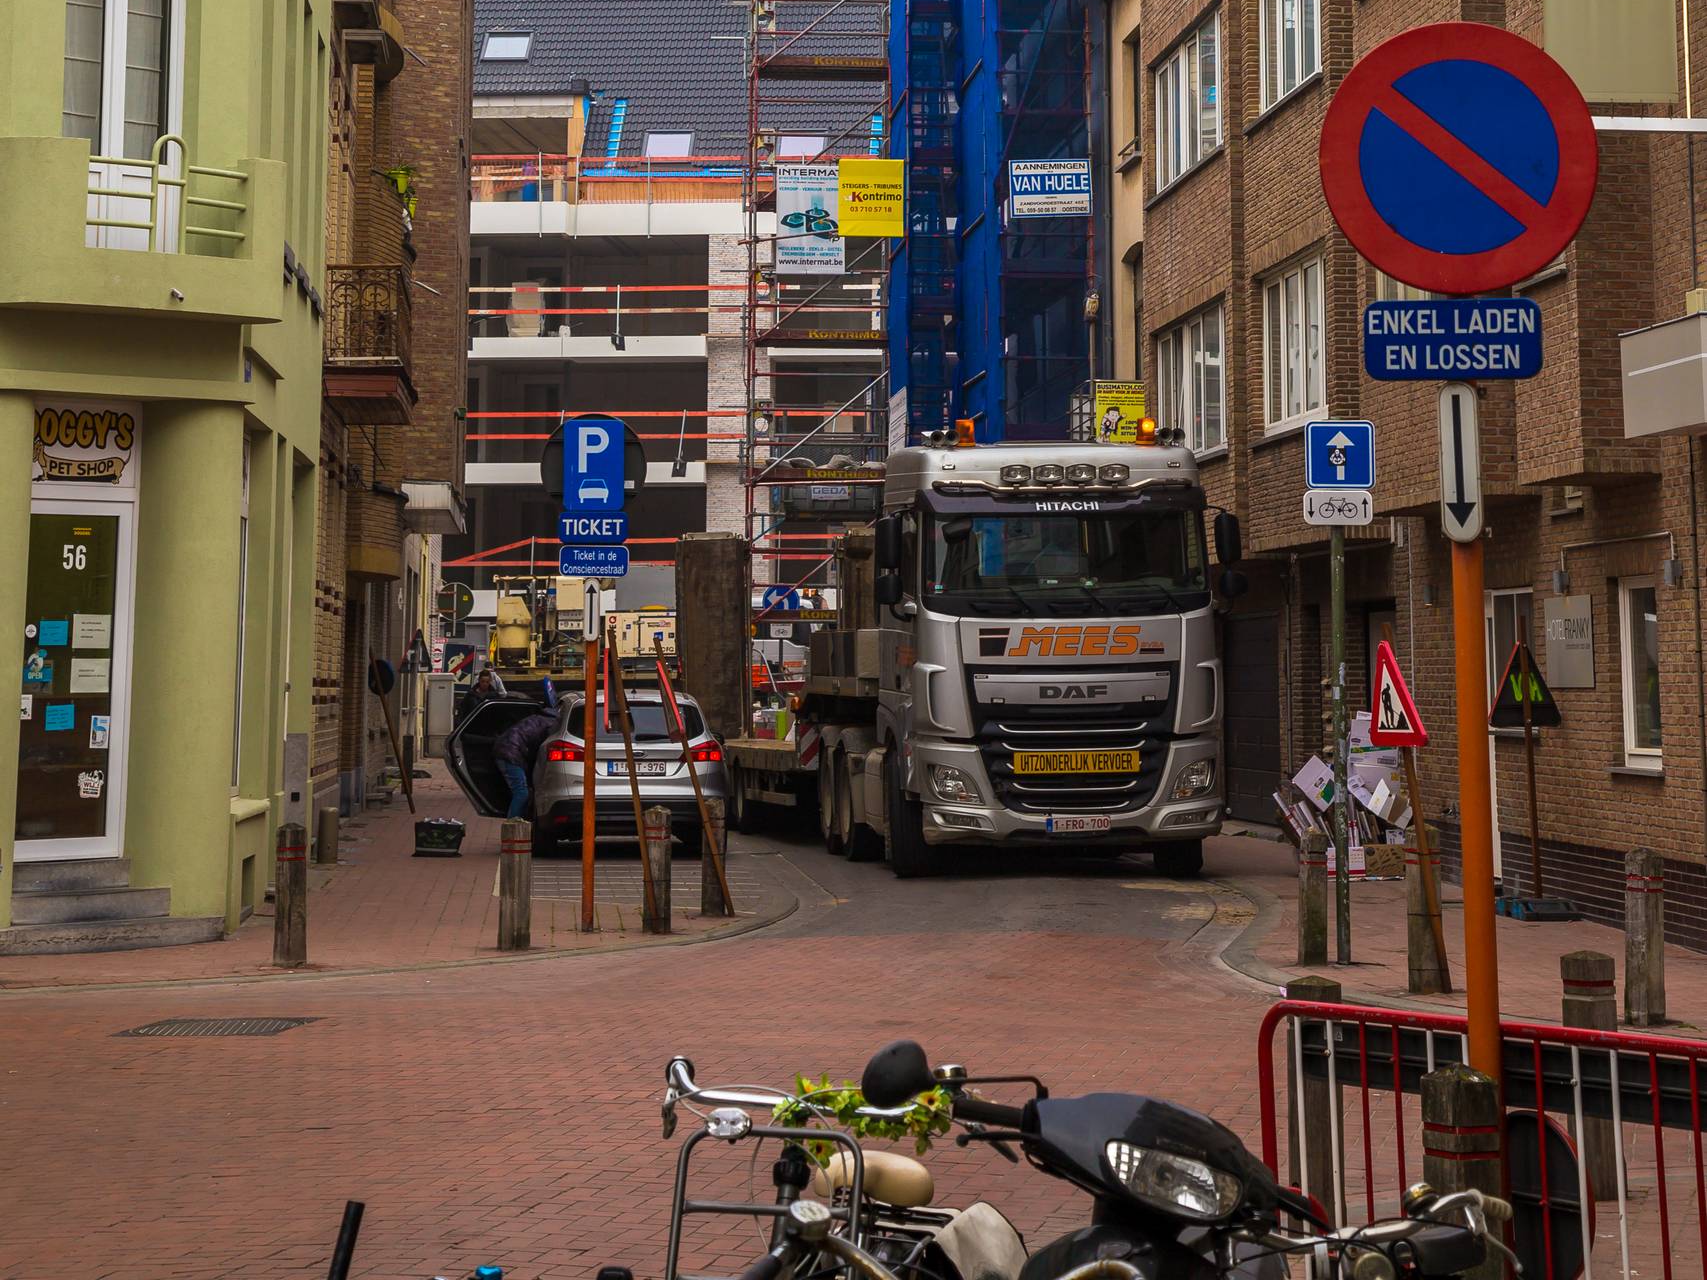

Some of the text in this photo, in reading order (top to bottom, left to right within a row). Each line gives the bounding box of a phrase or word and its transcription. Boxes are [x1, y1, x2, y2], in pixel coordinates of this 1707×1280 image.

[1012, 175, 1089, 191] VAN HUELE
[852, 192, 902, 202] Kontrimo
[778, 257, 843, 266] www.intermat.be
[1368, 308, 1535, 335] ENKEL LADEN
[1386, 344, 1520, 370] EN LOSSEN
[33, 408, 135, 451] OGGY'S
[578, 426, 610, 473] P
[49, 460, 114, 476] PET SHOP
[1035, 501, 1100, 511] HITACHI
[562, 519, 624, 536] TICKET
[62, 544, 87, 571] 56
[573, 550, 617, 561] Ticket in de
[562, 563, 624, 575] Consciencestraat
[1008, 625, 1141, 657] MEES
[1039, 685, 1107, 699] DAF
[1020, 753, 1132, 771] UITZONDERLIJK VERVOER
